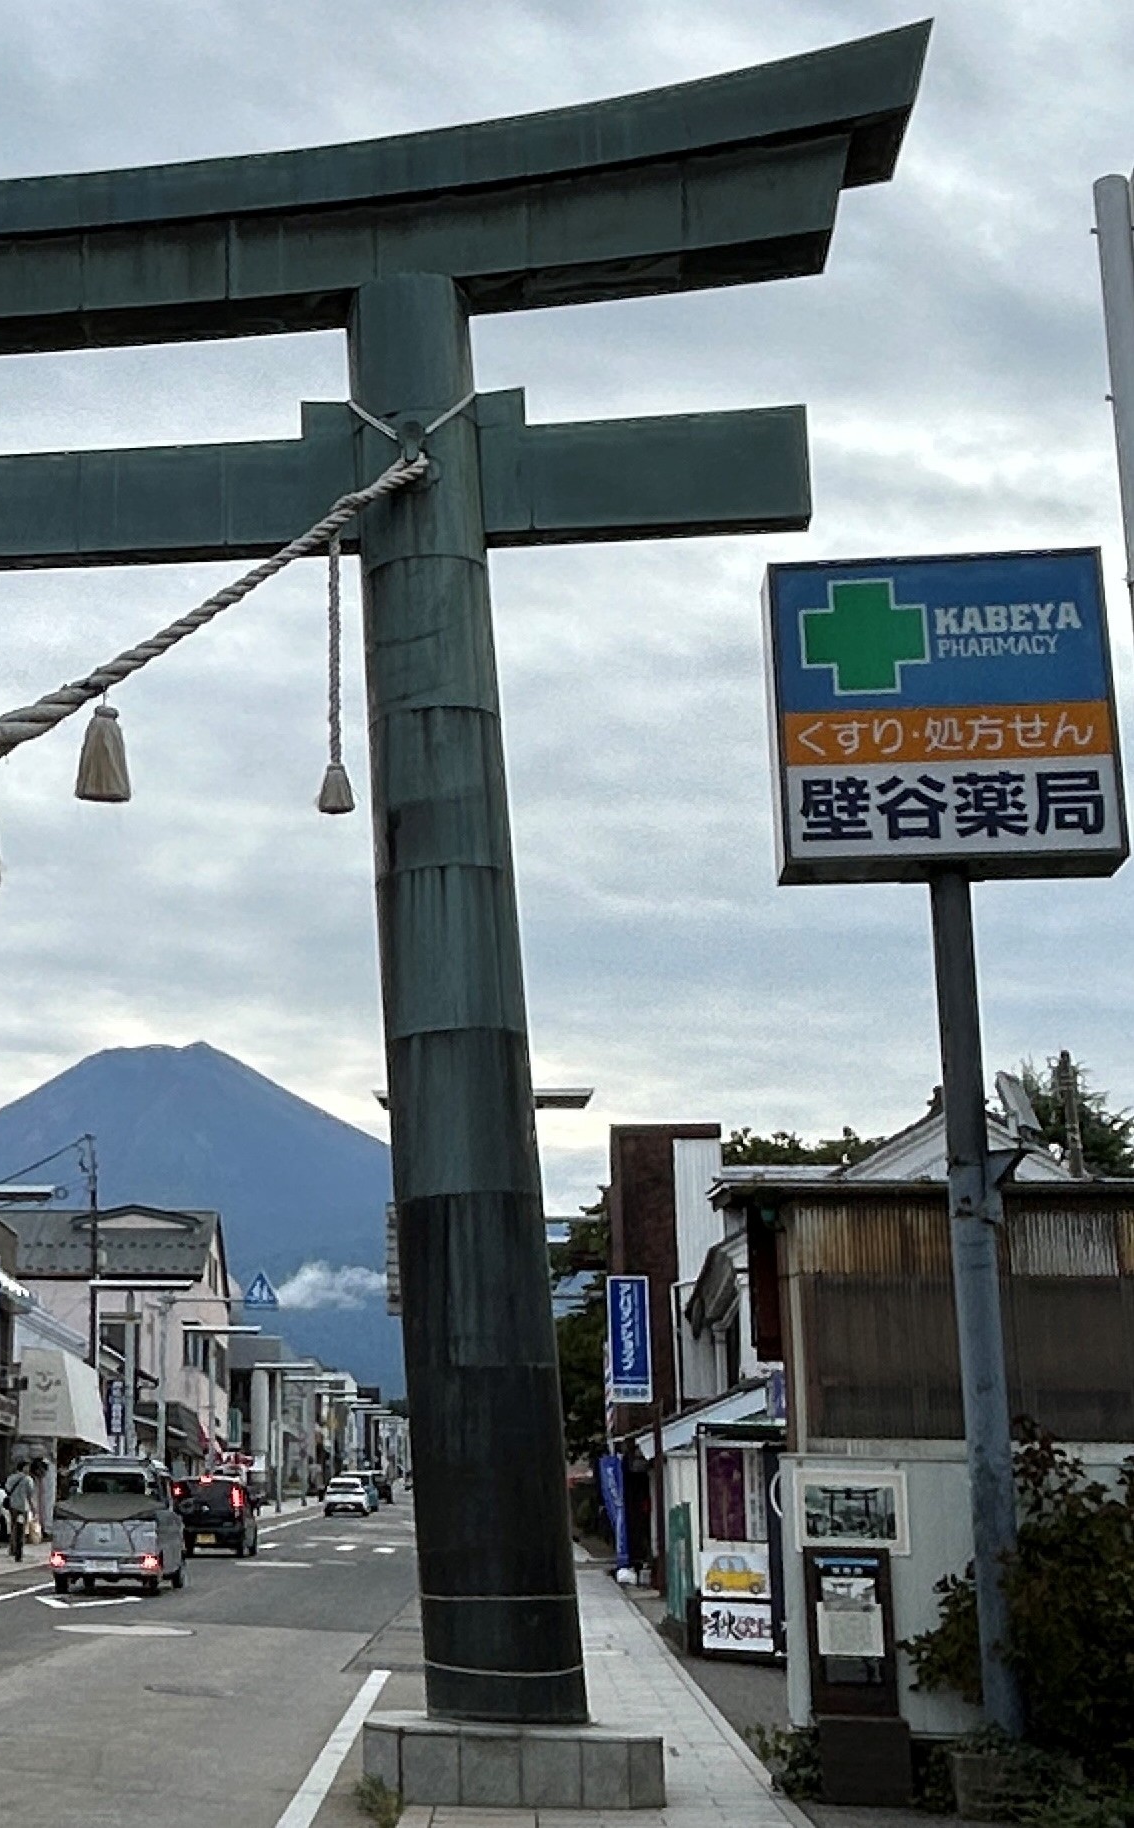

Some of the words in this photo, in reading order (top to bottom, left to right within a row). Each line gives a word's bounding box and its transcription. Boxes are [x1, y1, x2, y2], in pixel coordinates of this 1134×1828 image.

[933, 602, 1082, 636] KABEYA
[937, 634, 1059, 658] PHARMACY
[799, 769, 1106, 842] 壁谷薬局
